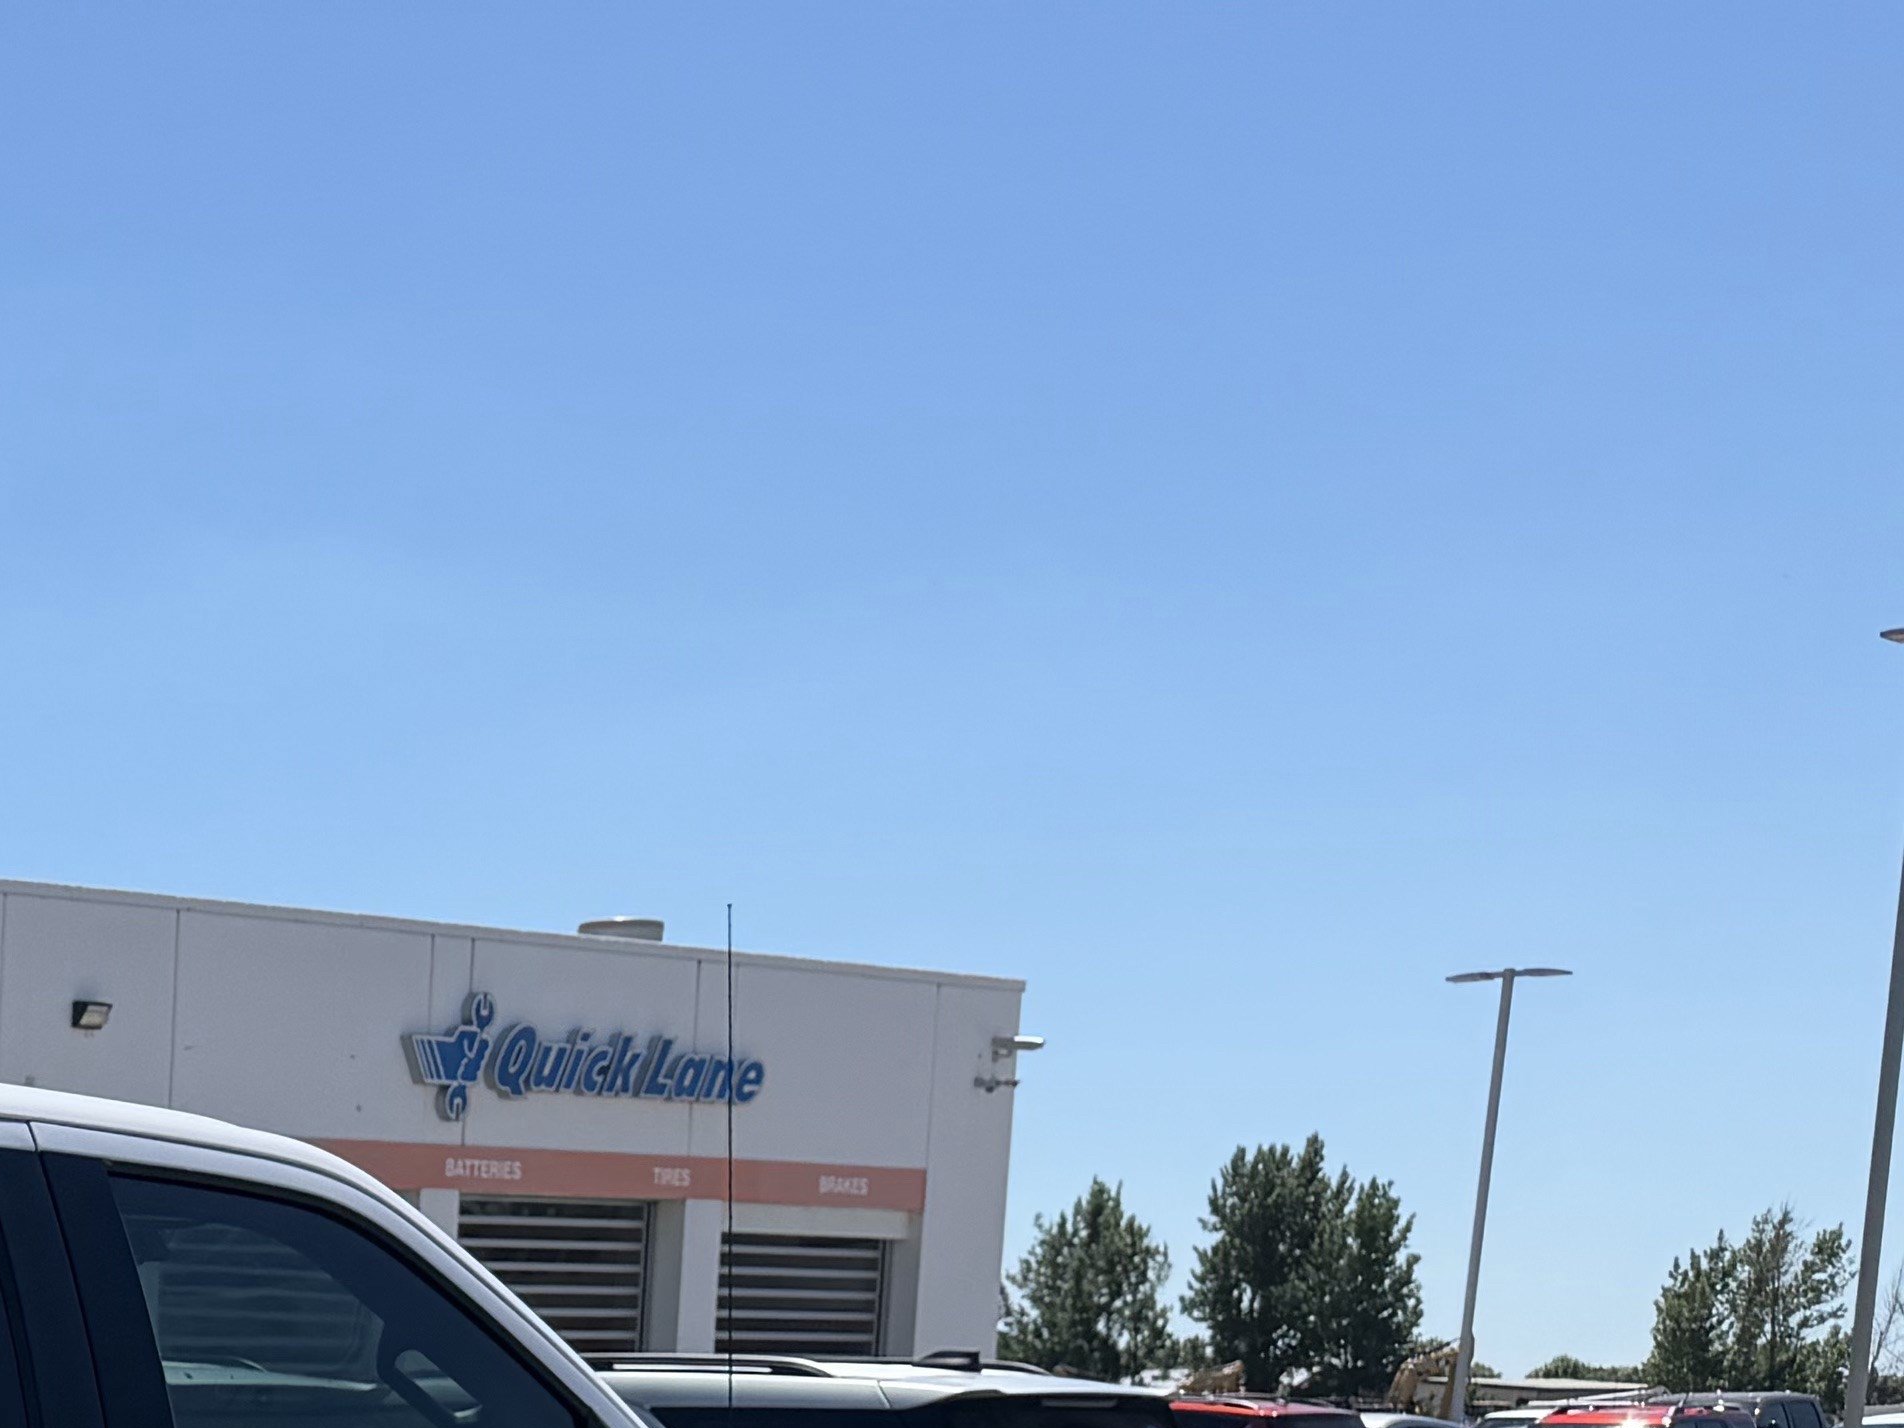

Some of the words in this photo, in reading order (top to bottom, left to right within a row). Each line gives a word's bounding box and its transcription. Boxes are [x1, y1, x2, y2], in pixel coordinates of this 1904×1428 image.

[496, 1023, 643, 1097] Quick
[642, 1037, 765, 1103] Lane
[445, 1157, 522, 1180] BATTERIES
[653, 1166, 691, 1188] TIRES
[819, 1175, 869, 1196] BRAKES
